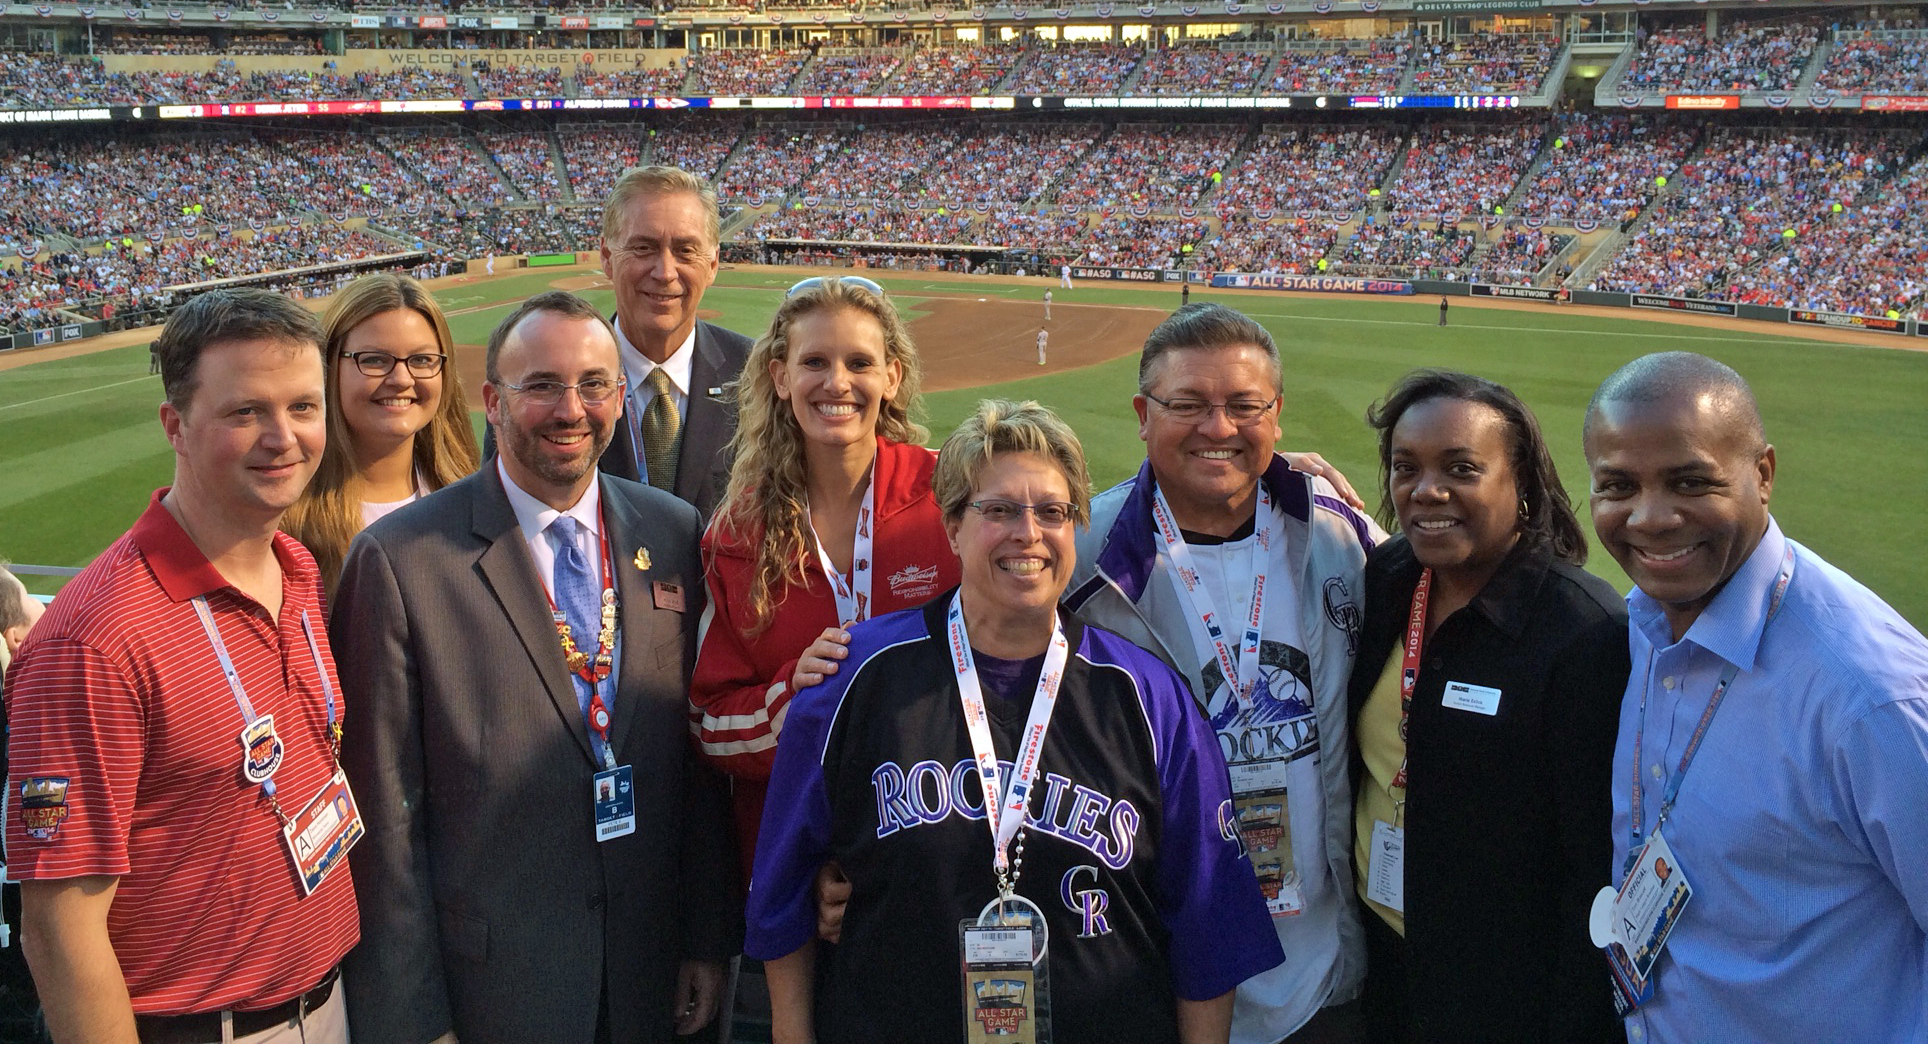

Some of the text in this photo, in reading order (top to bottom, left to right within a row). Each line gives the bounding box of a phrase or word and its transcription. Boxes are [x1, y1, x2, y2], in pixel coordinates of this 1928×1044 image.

[458, 18, 478, 27] FOX
[388, 53, 646, 64] WELCOME TO TARGET FIELD
[537, 100, 552, 108] #31
[1087, 269, 1112, 278] #ASG
[1130, 270, 1155, 280] #ASG
[1166, 272, 1180, 280] FOX
[1252, 273, 1404, 292] ALL STAR GAME 2014
[1500, 288, 1550, 298] MLB NETWORK
[64, 327, 80, 338] FOX
[1153, 497, 1175, 544] Fireston
[887, 570, 938, 588] Budweiser
[1252, 574, 1266, 628] Firestone
[1411, 591, 1425, 629] GAME
[952, 622, 967, 675] Firestone
[1408, 631, 1420, 658] 2014
[1216, 641, 1239, 692] irestone
[1214, 715, 1320, 762] OCKIE
[1021, 724, 1044, 782] Firestone
[250, 752, 281, 777] CLUBHOUSE
[39, 806, 65, 818] STAR
[310, 799, 327, 820] STAFF
[611, 806, 618, 814] B
[987, 784, 1000, 830] estone
[27, 817, 57, 828] GAME
[1250, 836, 1275, 846] GAME
[1260, 827, 1282, 837] STAR
[299, 835, 312, 858] A
[1627, 867, 1647, 898] OFFICIAL
[1623, 917, 1637, 941] A
[978, 1008, 1025, 1018] ALL STAR
[987, 1017, 1016, 1027] GAME
